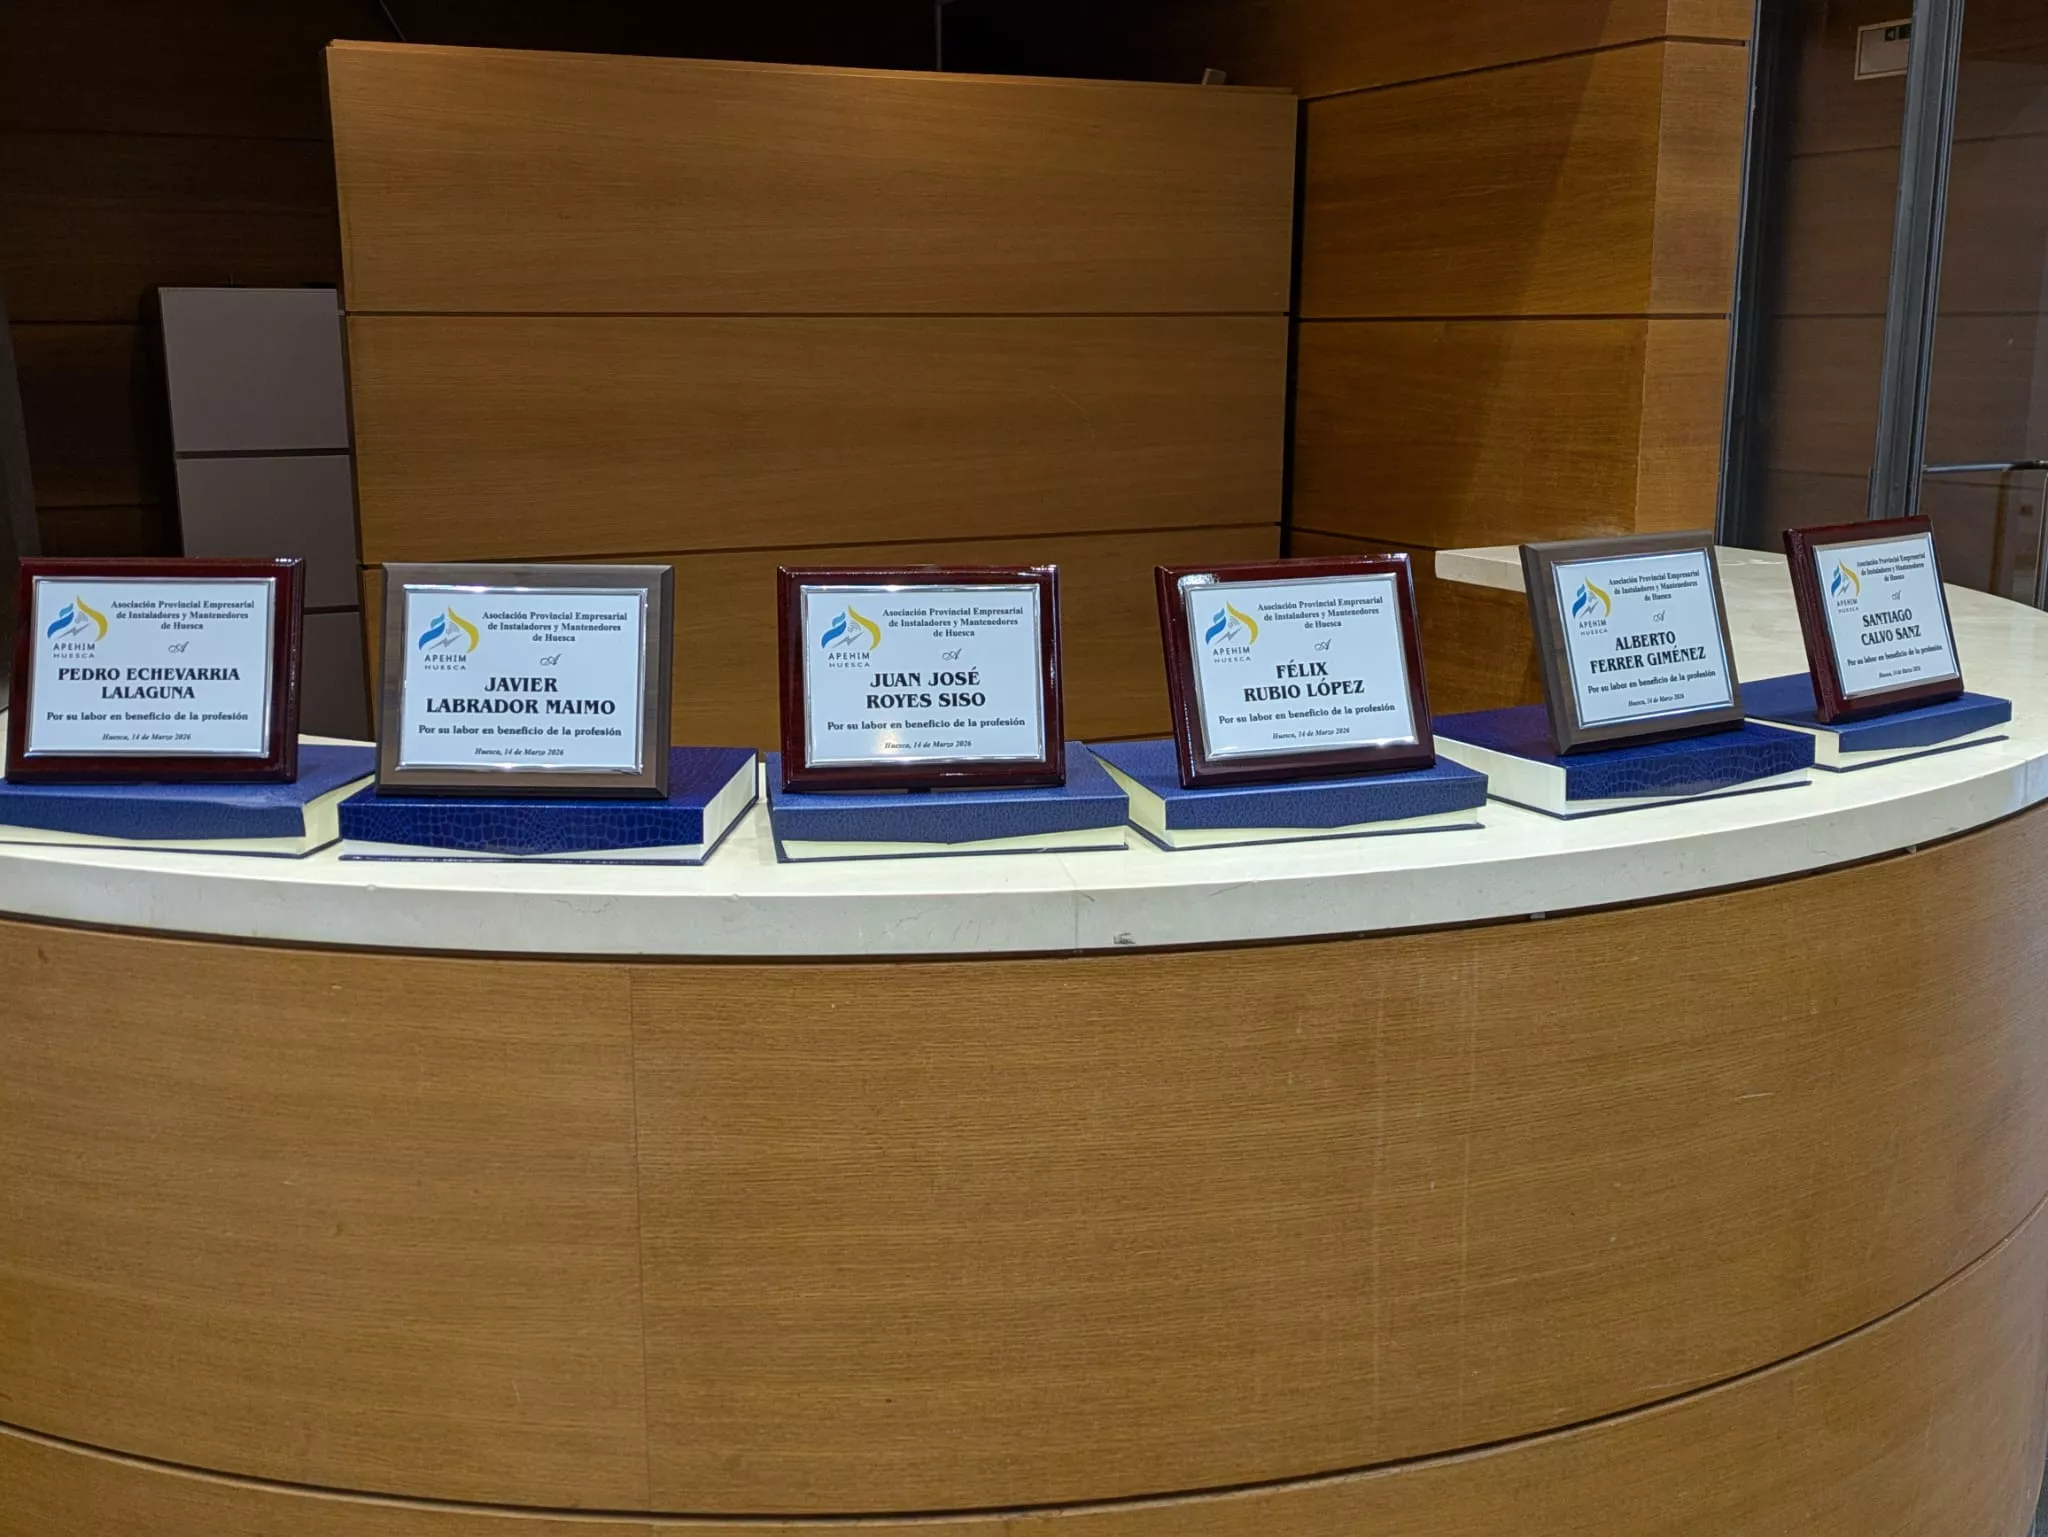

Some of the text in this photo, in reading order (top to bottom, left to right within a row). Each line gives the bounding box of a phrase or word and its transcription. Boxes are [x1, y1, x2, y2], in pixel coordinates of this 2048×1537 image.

[1609, 569, 1700, 586] Asociación Provincial Empresarial
[1621, 585, 1655, 594] Instaladores
[1660, 580, 1698, 590] Mantenedores
[1258, 596, 1383, 611] Asociación Provincial Empresarial
[1644, 593, 1672, 602] de Huesca
[111, 600, 254, 610] Asociación Provincial Empresarial
[116, 611, 249, 621] de Instaladores y Mantenedores
[482, 611, 627, 622] Asociación Provincial Empresarial
[882, 607, 1023, 617] Asociación Provincial Empresarial
[1263, 613, 1273, 621] de
[1274, 611, 1320, 621] Instaladores
[1327, 607, 1379, 617] Mantenedores
[1862, 608, 1912, 628] SANTIAGO
[160, 621, 204, 630] de Huesca
[487, 622, 498, 630] de
[500, 622, 551, 631] Instaladores
[561, 622, 621, 631] Mantenedores
[888, 617, 1018, 628] de Instaladores y Mantenedores
[1304, 620, 1342, 629] de Huesca
[1579, 619, 1607, 629] APEHIM
[532, 633, 576, 642] de Huesca
[933, 629, 975, 637] de Huesca
[1580, 628, 1608, 636] HUESCA
[1861, 625, 1921, 646] CALVO SANZ
[53, 643, 95, 651] APEHIM
[1314, 638, 1332, 651] A
[1615, 631, 1676, 651] ALBERTO
[828, 652, 870, 660] APEHIM
[942, 648, 962, 661] A
[1213, 646, 1250, 656] APEHIM
[424, 654, 466, 662] APEHIM
[540, 653, 562, 666] A
[1590, 645, 1706, 674] FERRER GIMÉNEZ
[58, 668, 240, 681] PEDRO ECHEVARRIA
[1276, 659, 1328, 679] FÉLIX
[870, 666, 980, 688] JUAN JOSÉ
[1587, 685, 1599, 694] Por
[1609, 682, 1627, 690] labor
[1638, 676, 1669, 687] beneficio
[1669, 674, 1678, 682] de
[1678, 673, 1686, 681] la
[1686, 669, 1716, 682] profesión
[484, 677, 558, 692] JAVIER
[1244, 677, 1365, 702] RUBIO LÓPEZ
[102, 686, 195, 699] LALAGUNA
[426, 698, 615, 715] LABRADOR MAIMO
[866, 692, 986, 709] ROYES SISO
[47, 712, 64, 721] Por
[81, 712, 107, 720] labor
[125, 712, 171, 720] beneficio
[174, 711, 186, 720] de
[189, 711, 199, 720] la
[202, 711, 248, 722] profesión
[1218, 715, 1234, 724] Por
[1249, 712, 1272, 722] labor
[1288, 708, 1329, 719] beneficio
[1331, 706, 1342, 716] de
[1344, 706, 1353, 714] la
[1355, 703, 1395, 715] profesión
[418, 724, 436, 734] Por
[453, 725, 479, 734] labor
[497, 725, 544, 735] beneficio
[546, 726, 559, 735] de
[562, 726, 571, 735] la
[574, 726, 622, 737] profesión
[827, 721, 844, 731] Por
[861, 721, 887, 730] labor
[905, 719, 951, 728] beneficio
[953, 718, 965, 727] de
[968, 718, 977, 727] la
[980, 717, 1025, 729] profesión
[102, 733, 129, 741] Huesca,
[1335, 727, 1350, 735] 2026
[932, 740, 954, 748] Marzo
[955, 740, 972, 748] 2026
[474, 748, 502, 756] Huesca,
[524, 748, 546, 756] Marzo
[547, 748, 564, 756] 2026
